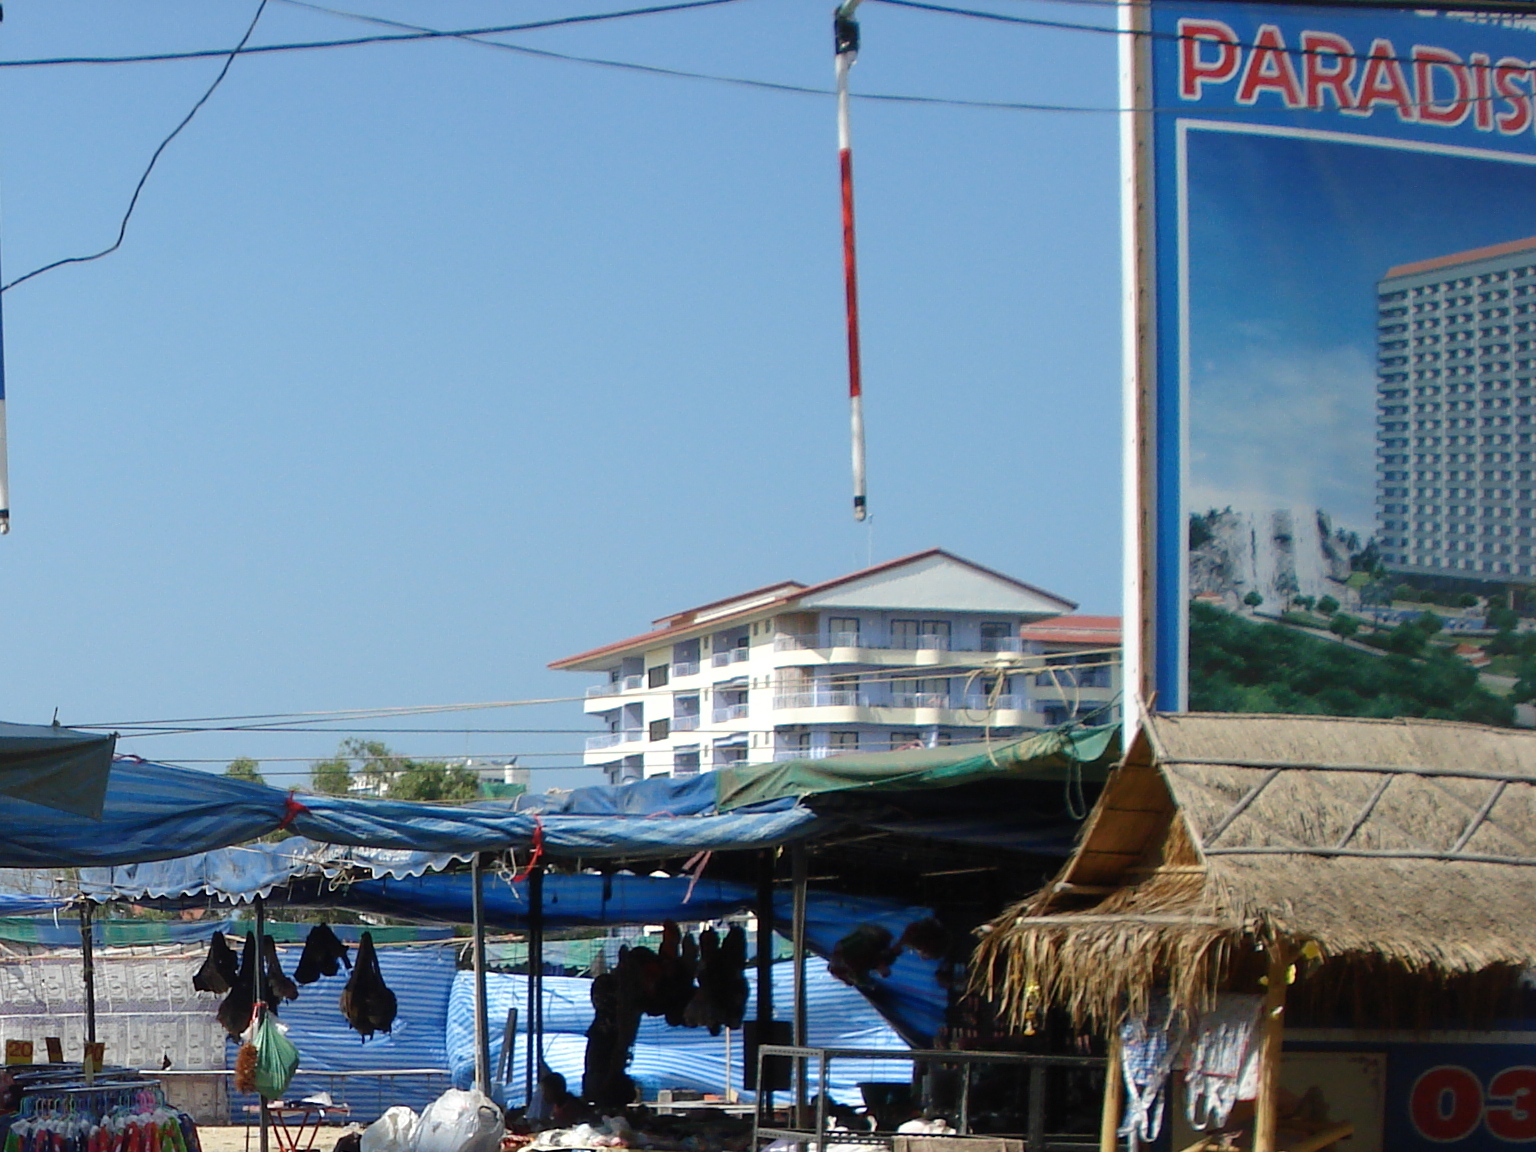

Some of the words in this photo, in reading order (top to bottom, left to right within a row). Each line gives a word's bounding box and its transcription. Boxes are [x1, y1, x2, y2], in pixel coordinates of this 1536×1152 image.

[1177, 17, 1536, 136] PARADIS
[8, 1041, 33, 1058] 20
[1409, 1064, 1536, 1143] 03
